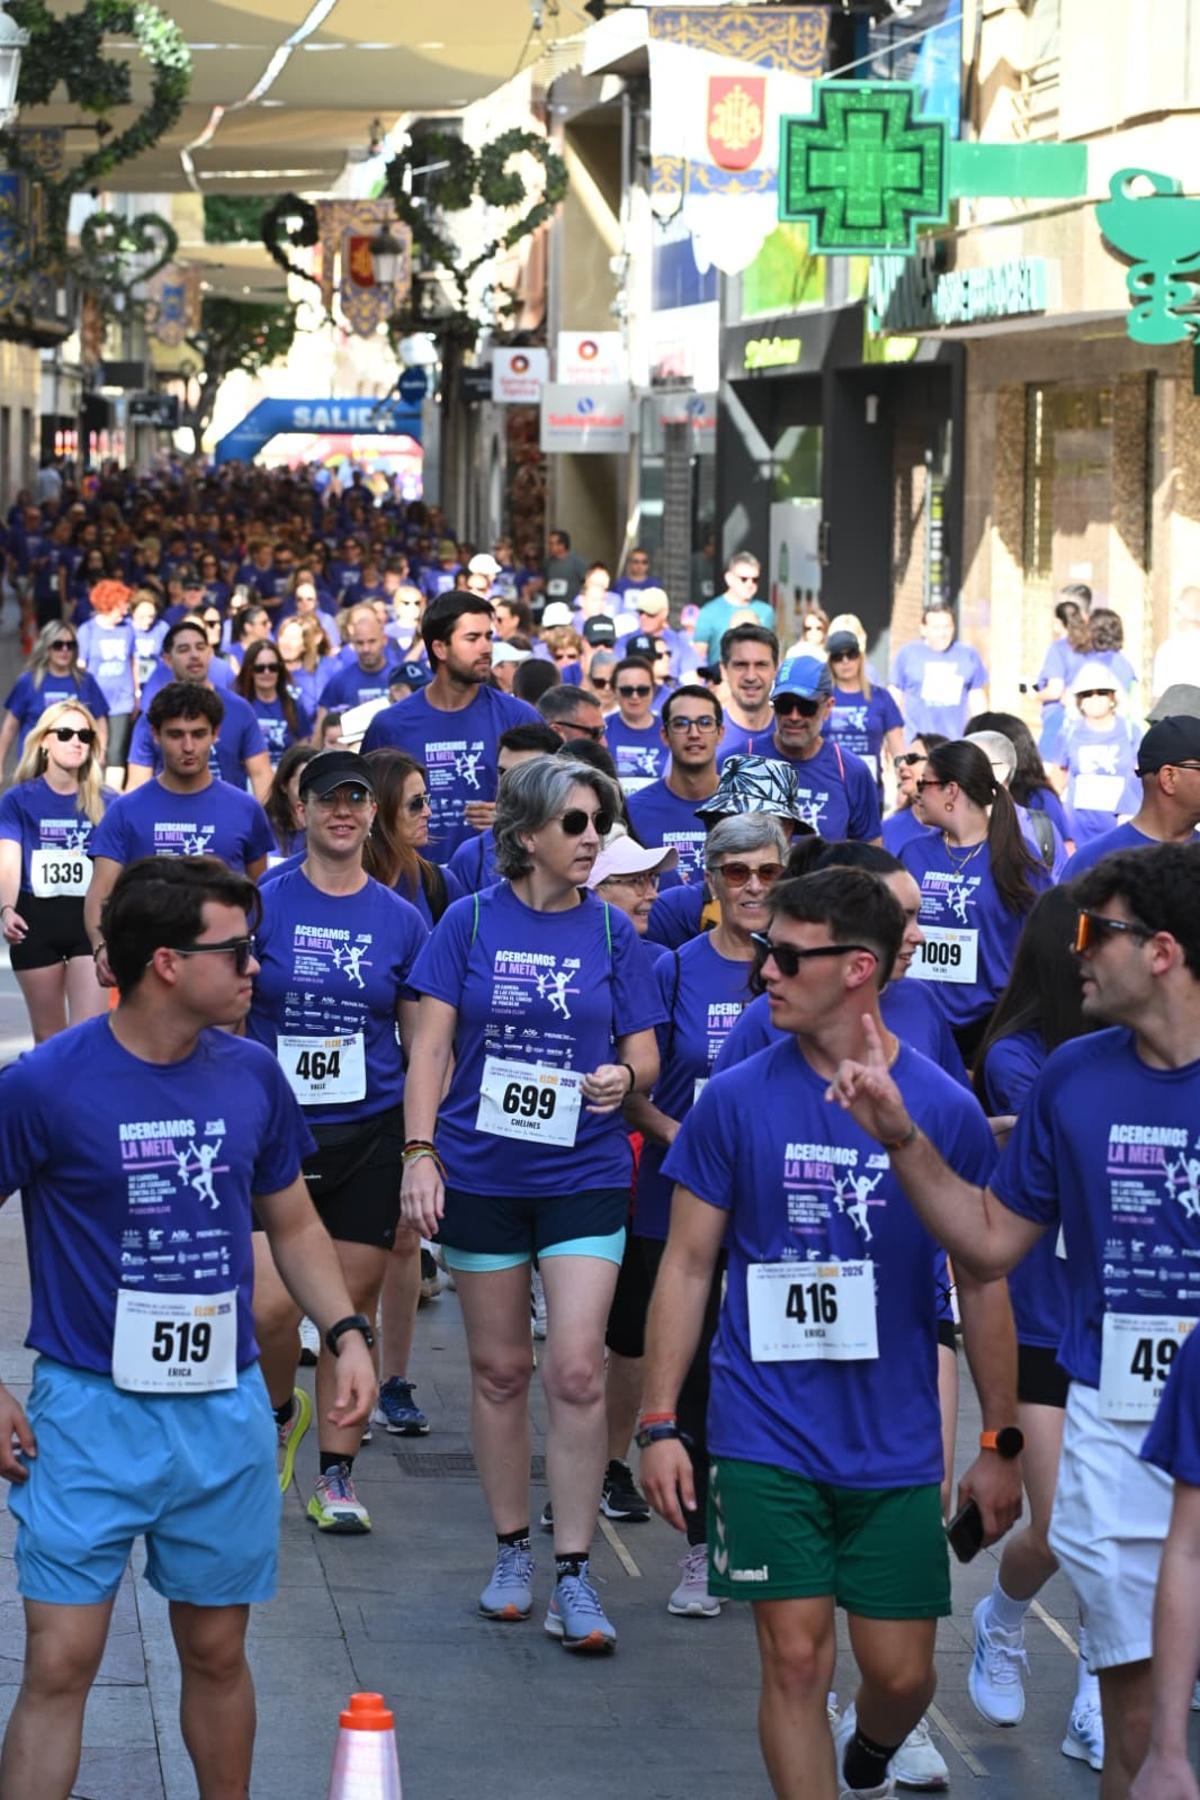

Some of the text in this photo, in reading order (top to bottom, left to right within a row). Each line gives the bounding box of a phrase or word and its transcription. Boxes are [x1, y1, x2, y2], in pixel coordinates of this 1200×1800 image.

[42, 862, 83, 884] 1339
[294, 935, 334, 950] LA META
[295, 924, 351, 941] ACERCAMOS
[495, 950, 556, 967] ACERCAMOS
[920, 942, 962, 966] 1009
[494, 961, 537, 977] LA META
[708, 1002, 742, 1016] ACERC
[708, 1015, 720, 1028] LA
[296, 1050, 341, 1081] 464
[502, 1082, 557, 1120] 699
[119, 1119, 196, 1141] ACERCAMOS
[510, 1118, 541, 1130] CHELINES
[1108, 1124, 1188, 1148] ACERCAMOS
[121, 1139, 175, 1159] LA META
[785, 1143, 859, 1167] ACERCAMOS
[1108, 1143, 1165, 1164] LA META
[784, 1161, 834, 1180] LA META
[786, 1283, 838, 1324] 416
[152, 1321, 212, 1363] 519
[1130, 1338, 1180, 1381] 49
[168, 1368, 192, 1377] ERICA
